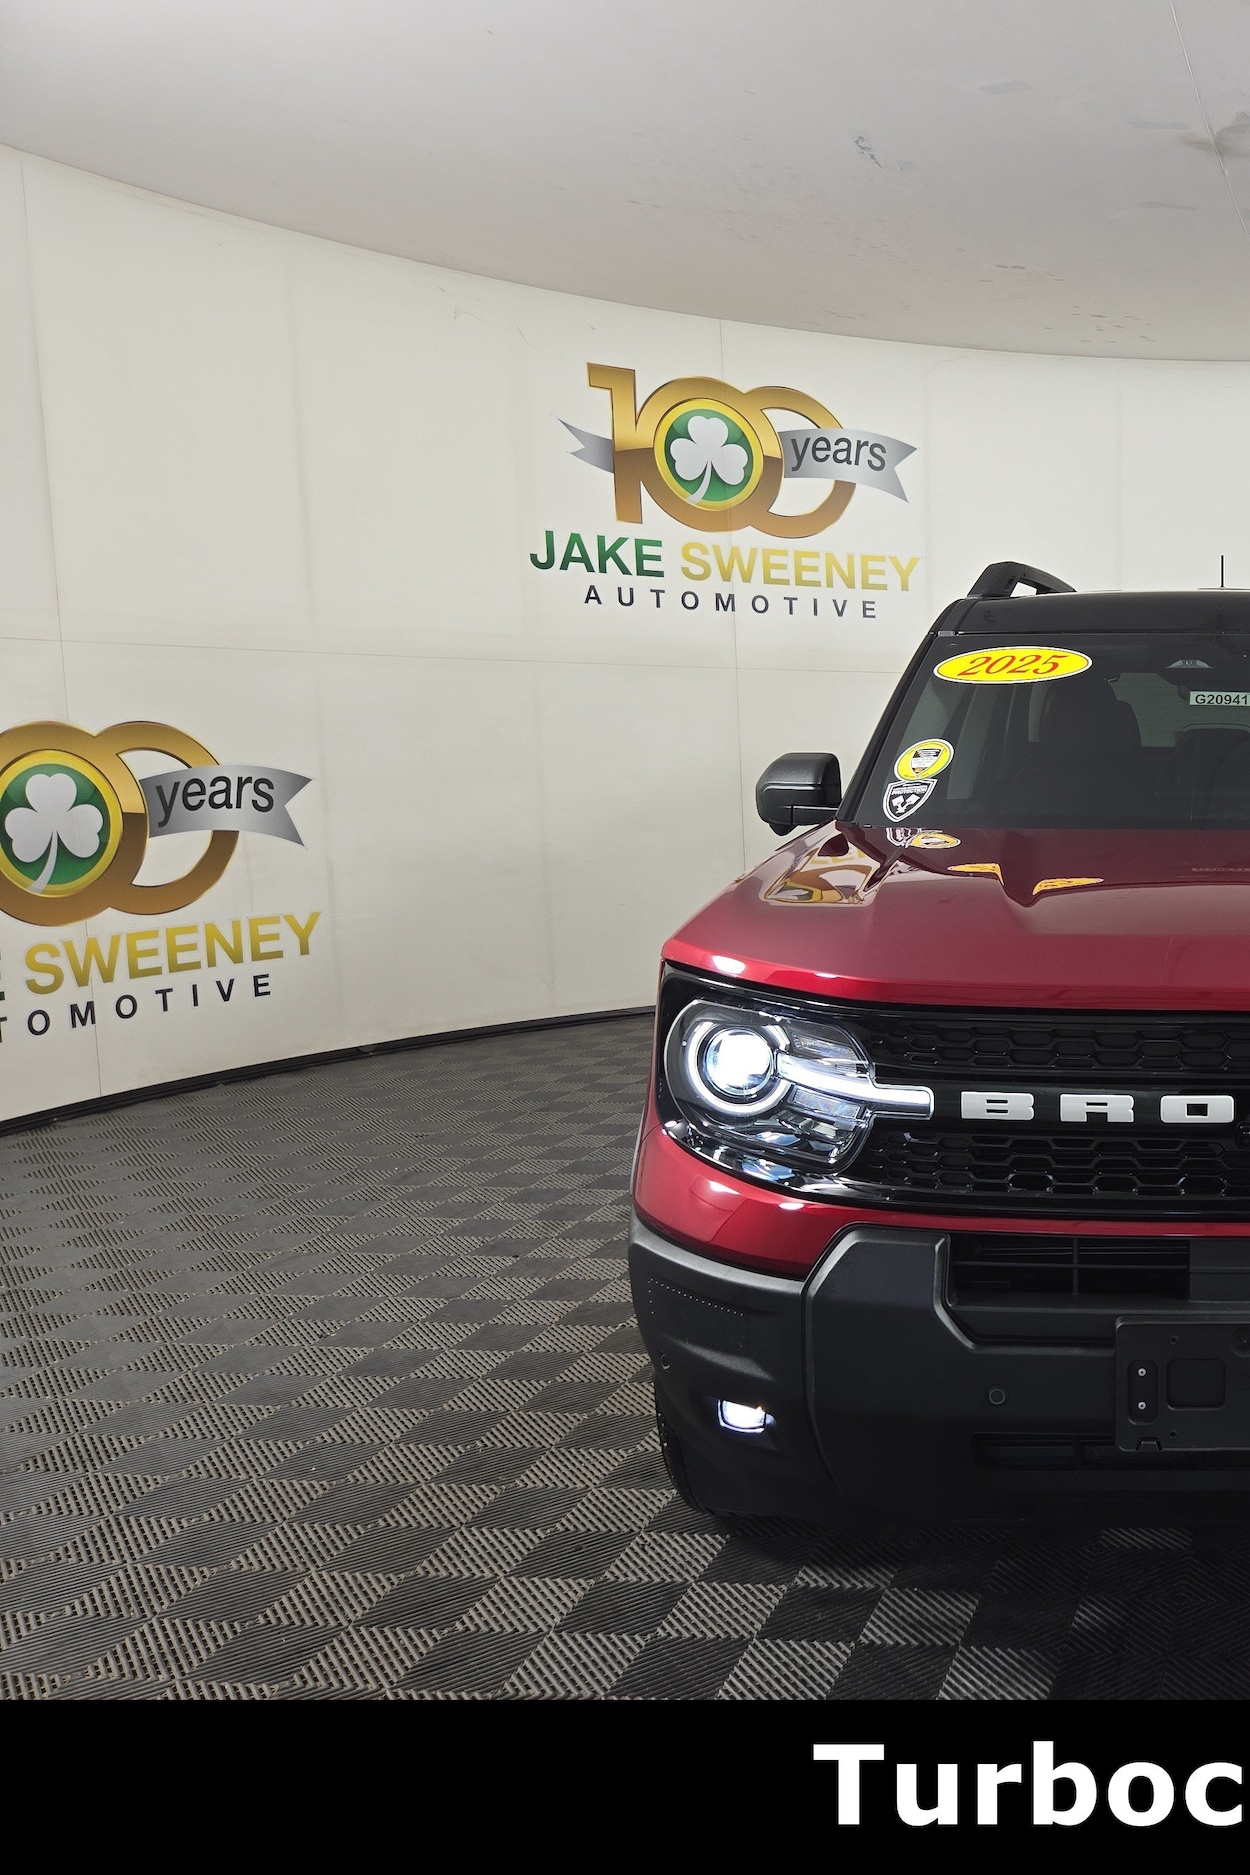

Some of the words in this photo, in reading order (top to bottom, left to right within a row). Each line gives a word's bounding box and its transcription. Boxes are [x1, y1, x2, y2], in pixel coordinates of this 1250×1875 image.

[790, 436, 887, 471] years
[529, 530, 665, 578] JAKE
[680, 541, 920, 592] SWEENEY
[584, 584, 876, 619] AUTOMOTIVE
[957, 655, 1068, 676] 2025
[1195, 694, 1248, 705] G20941
[155, 775, 275, 828] years
[24, 911, 321, 995] SWEENEY
